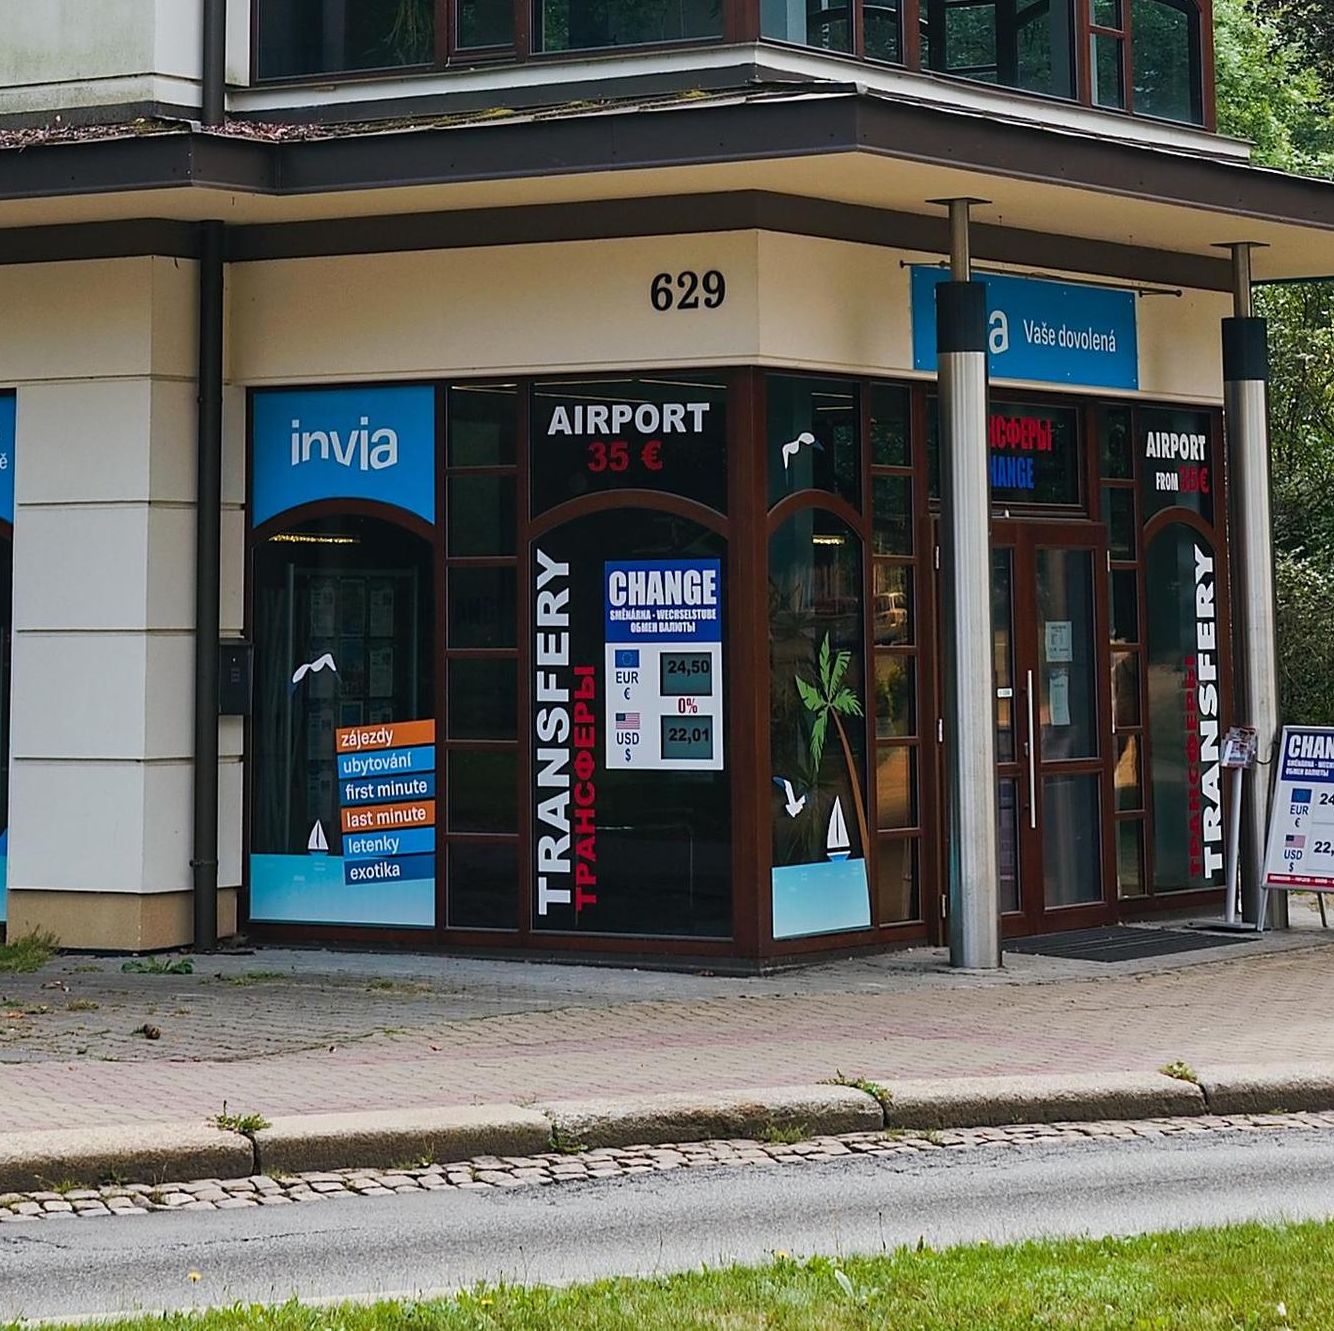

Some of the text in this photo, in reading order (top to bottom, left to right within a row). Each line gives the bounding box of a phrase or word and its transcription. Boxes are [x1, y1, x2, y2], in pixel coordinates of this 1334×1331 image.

[650, 270, 725, 311] 629
[1023, 319, 1056, 346] Vaše
[1058, 324, 1116, 353] dovolená
[548, 403, 710, 435] AIRPORT
[291, 416, 398, 471] invia
[1146, 431, 1206, 461] AIRPORT
[587, 440, 663, 472] 35 €
[1155, 471, 1179, 491] FROM
[609, 570, 717, 606] CHANGE
[615, 671, 639, 684] EUR
[668, 660, 709, 677] 24,50
[624, 687, 631, 700] €
[678, 697, 698, 714] 0%
[1194, 544, 1223, 878] TRANSFERY
[341, 727, 393, 749] zájezdy
[536, 549, 571, 915] TRANSFERY
[616, 732, 640, 745] USD
[668, 727, 709, 745] 22,01
[343, 751, 411, 776] ubytování
[625, 747, 632, 762] $
[345, 780, 427, 800] first minute
[572, 665, 597, 911] ТРАНСФЕРЫ
[347, 807, 426, 827] last minute
[1290, 805, 1309, 815] EUR
[348, 835, 399, 854] letenky
[1284, 850, 1303, 860] USD
[350, 863, 400, 880] exotika
